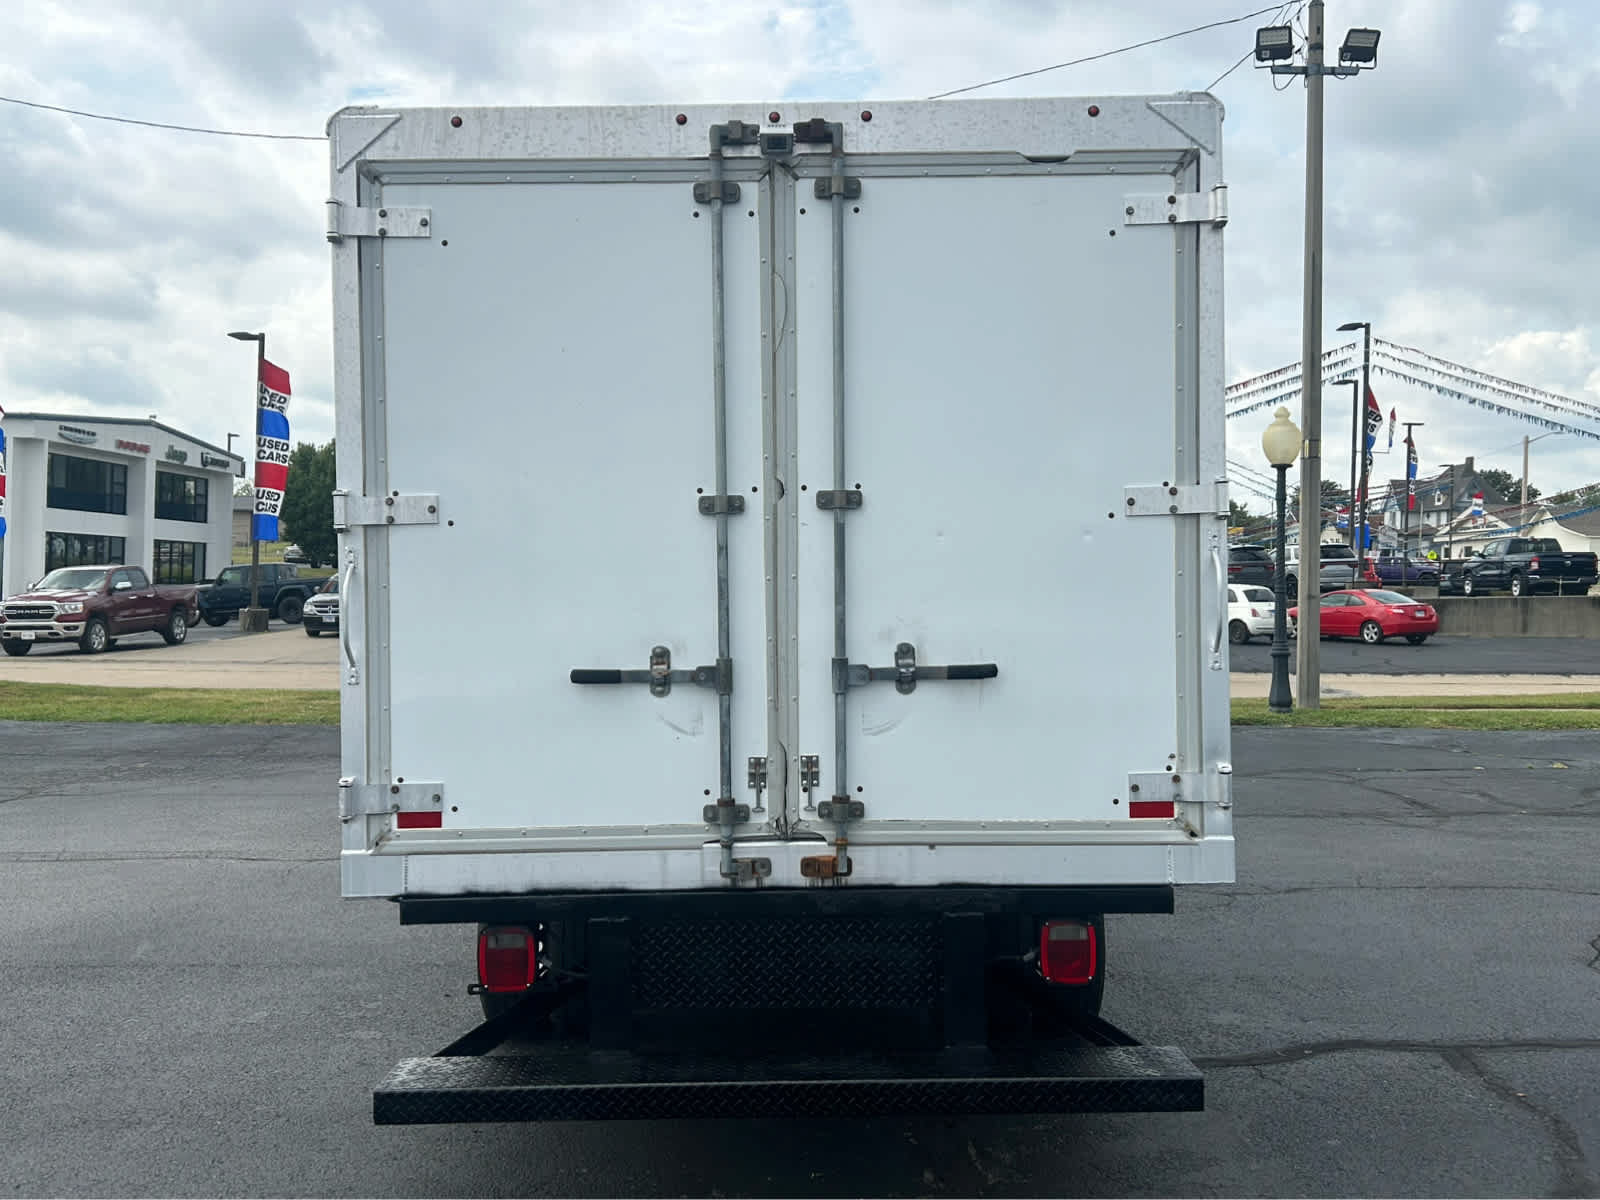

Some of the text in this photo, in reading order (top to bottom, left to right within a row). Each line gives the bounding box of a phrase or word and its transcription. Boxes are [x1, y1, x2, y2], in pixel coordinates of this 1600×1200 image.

[1368, 410, 1382, 422] ED
[257, 437, 289, 452] USED
[257, 449, 288, 464] CARS
